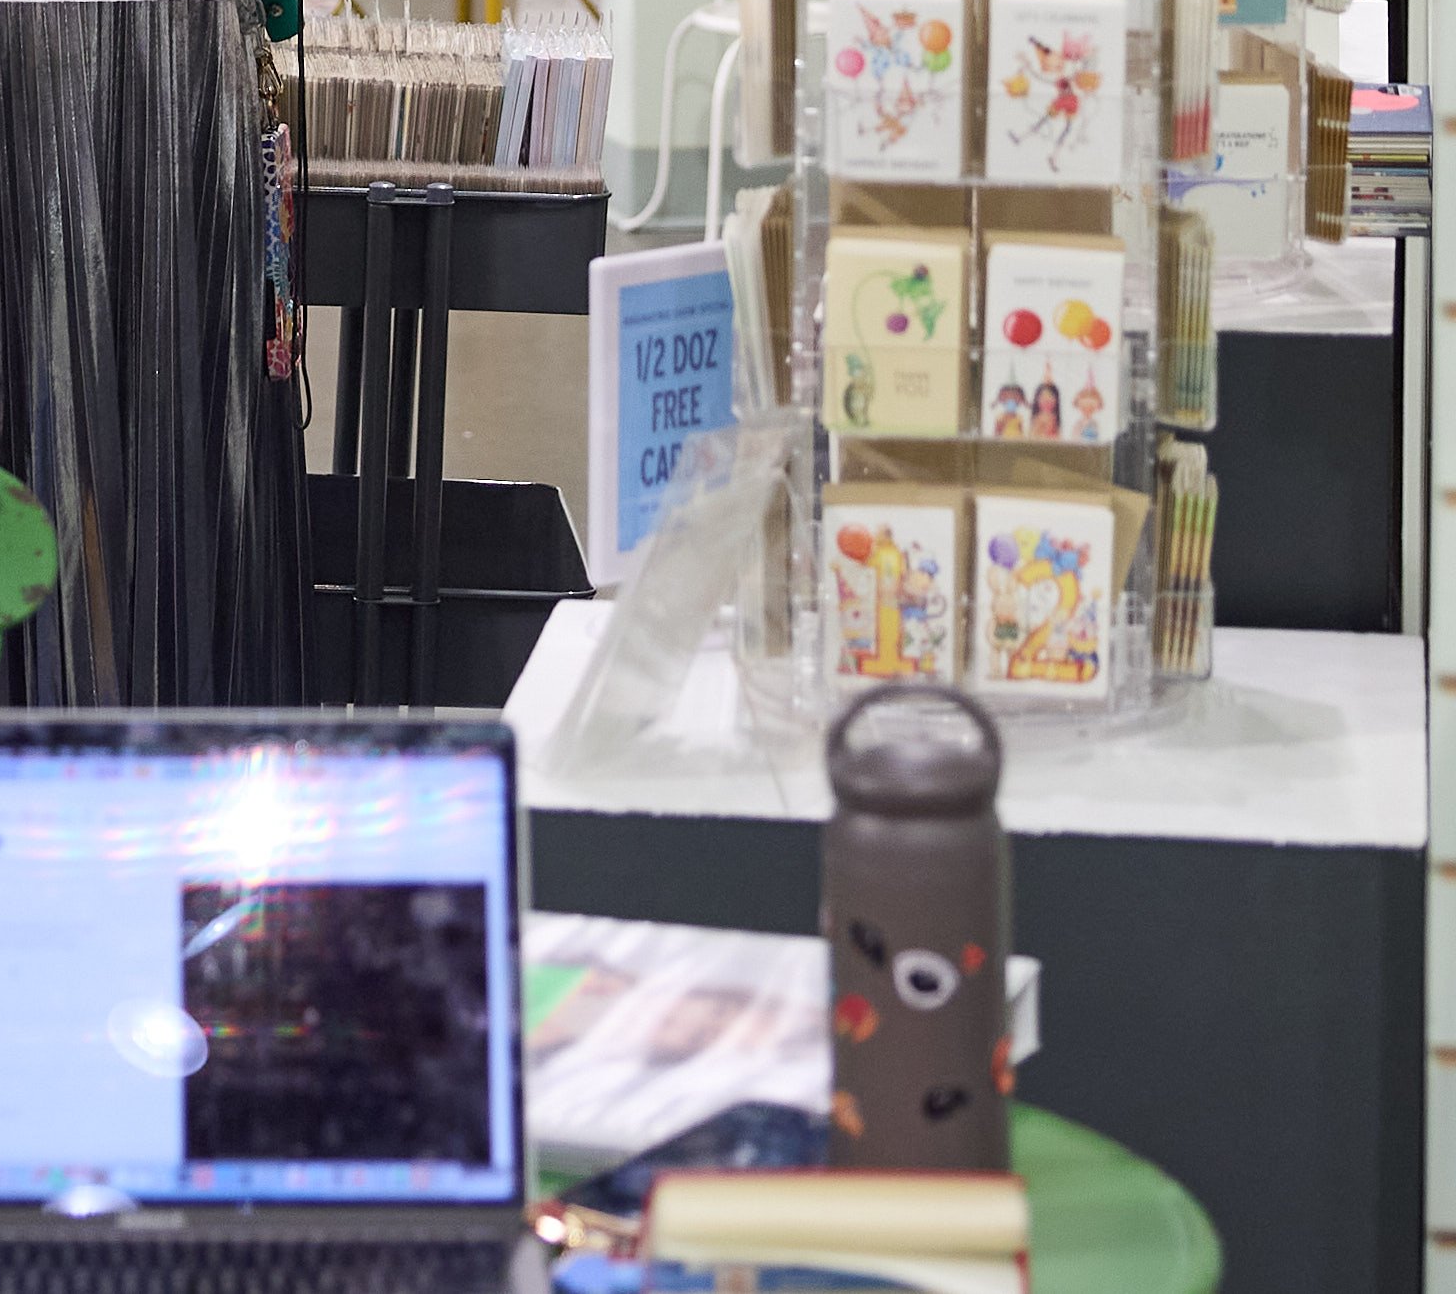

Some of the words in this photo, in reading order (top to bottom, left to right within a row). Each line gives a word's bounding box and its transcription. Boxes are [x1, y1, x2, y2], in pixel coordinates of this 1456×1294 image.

[636, 336, 666, 383] 1/2
[672, 327, 720, 377] DOZ
[650, 384, 703, 435] FREE
